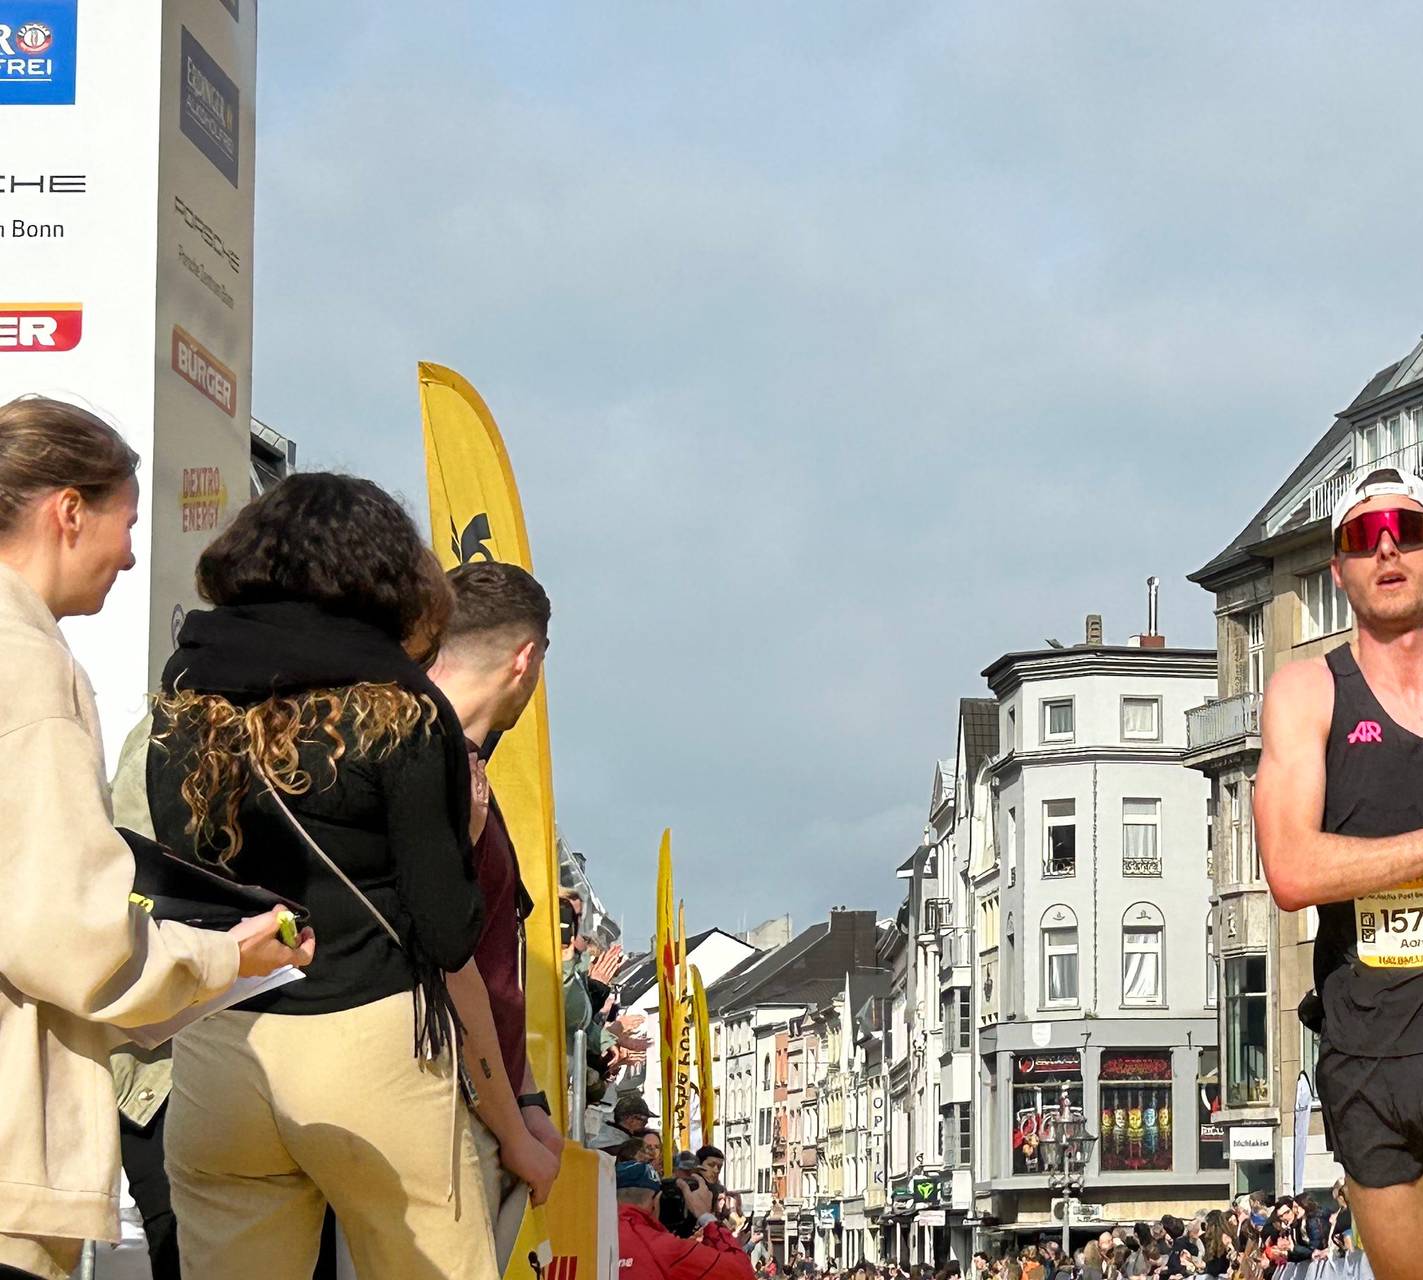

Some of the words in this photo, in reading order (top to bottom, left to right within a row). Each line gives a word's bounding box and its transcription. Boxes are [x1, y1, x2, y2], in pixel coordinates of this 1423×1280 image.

[12, 219, 64, 238] Bonn
[178, 341, 232, 410] BÜRGER
[183, 466, 220, 499] DEXTRO
[873, 1097, 884, 1185] OPTIK
